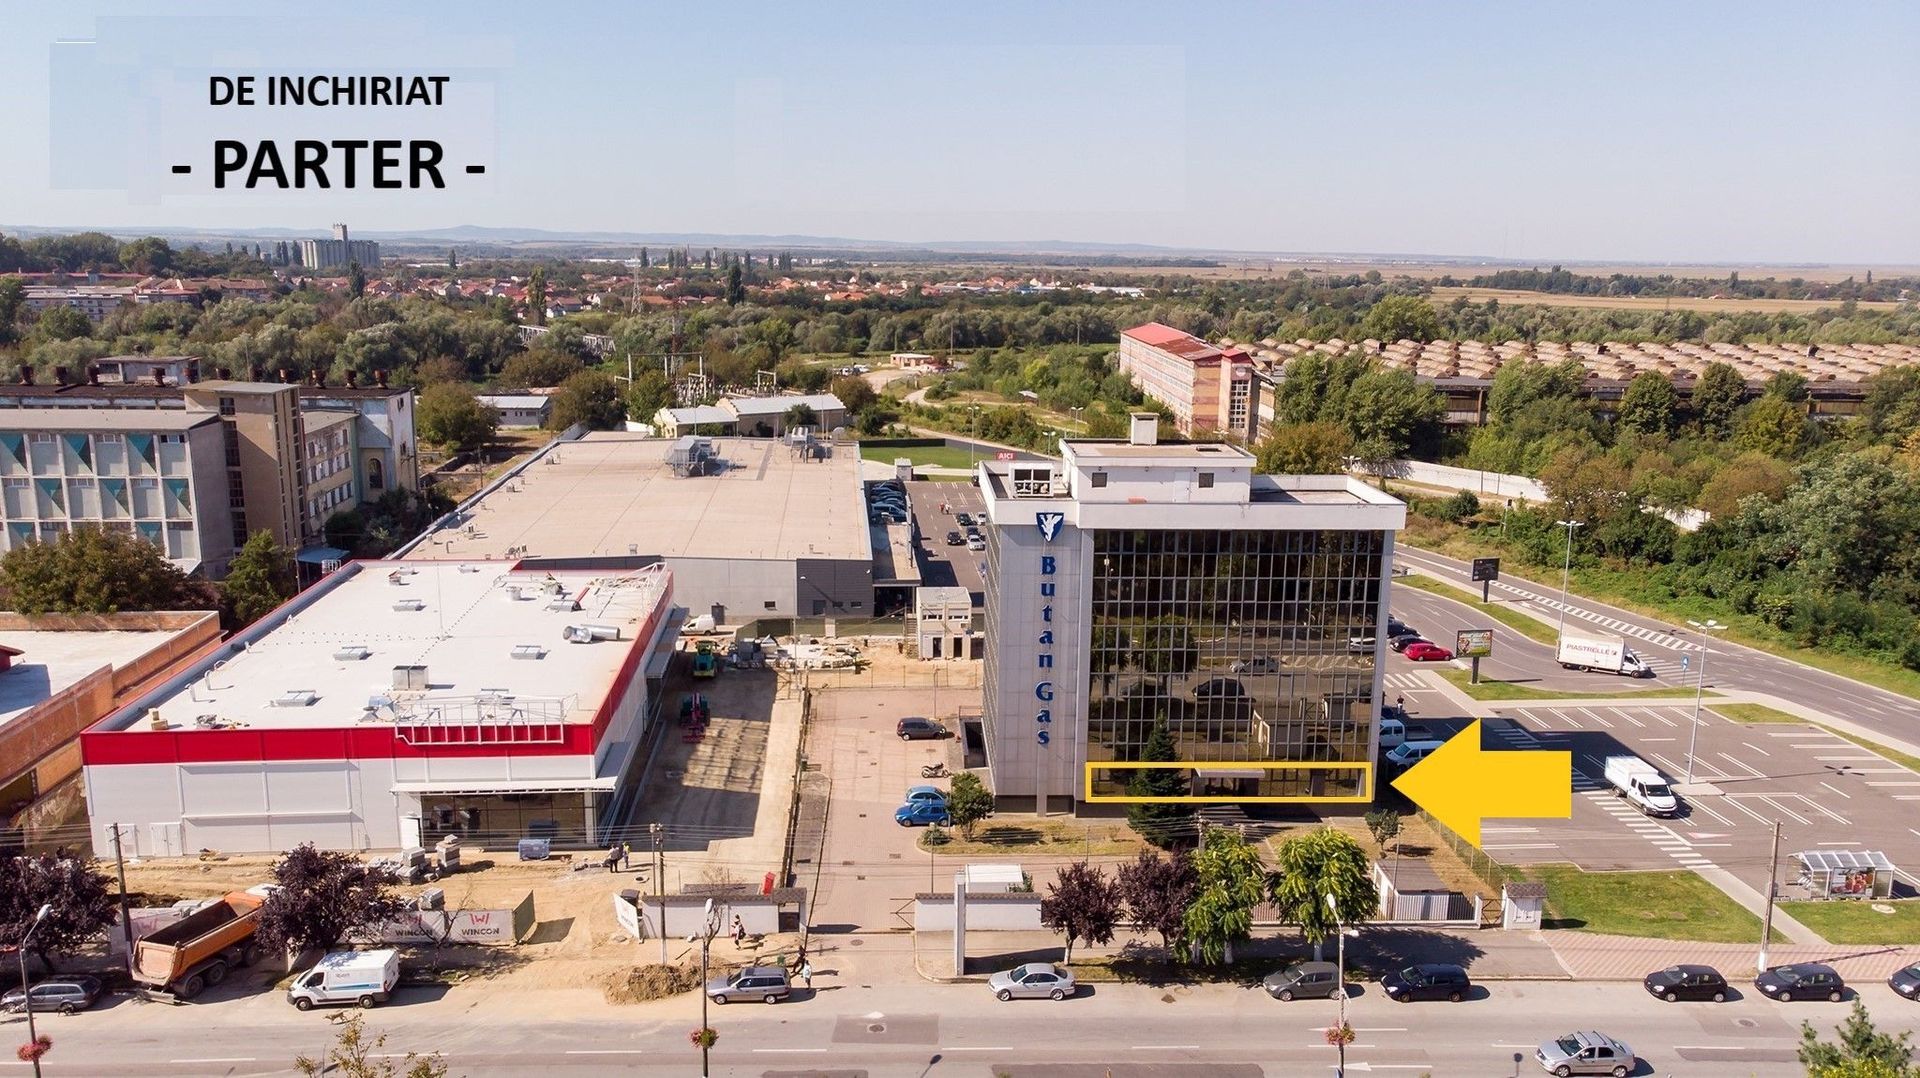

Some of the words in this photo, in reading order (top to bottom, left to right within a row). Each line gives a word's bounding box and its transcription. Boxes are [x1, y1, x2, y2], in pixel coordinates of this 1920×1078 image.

[998, 452, 1014, 460] AICI
[1038, 555, 1057, 668] Butan
[1566, 643, 1610, 655] PIASTRELLE
[1035, 681, 1054, 745] Gas
[395, 929, 433, 937] WINCON
[461, 927, 500, 936] WINCON
